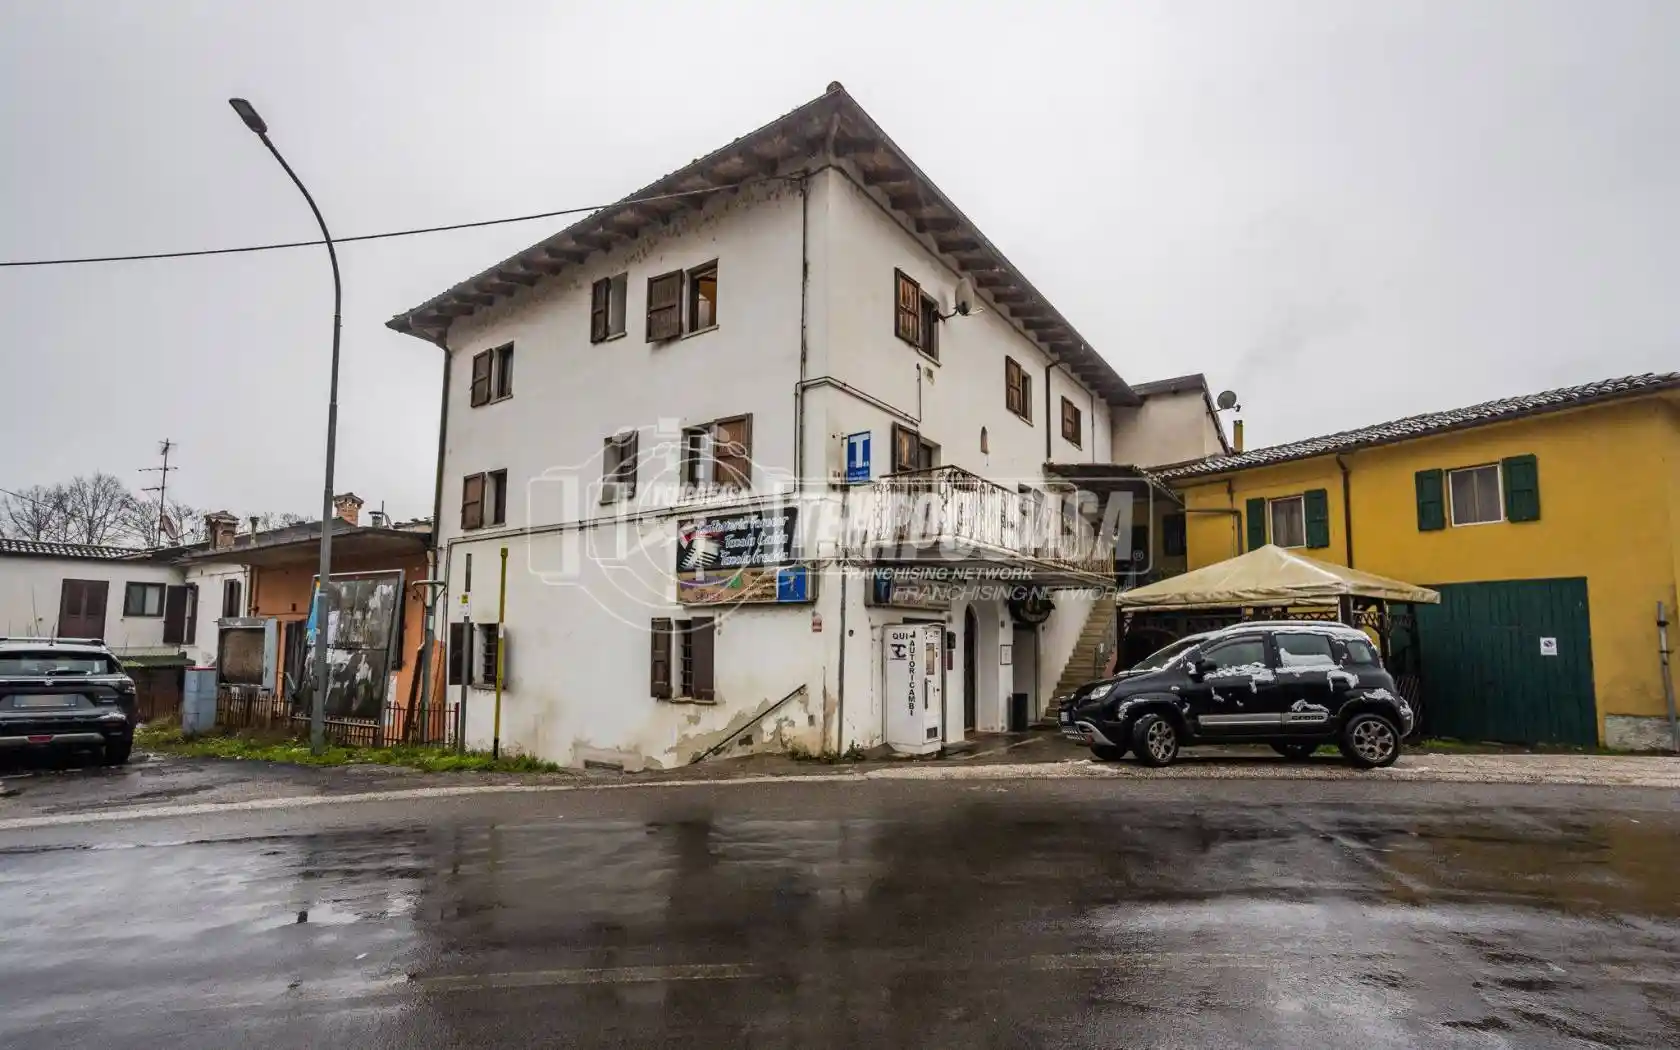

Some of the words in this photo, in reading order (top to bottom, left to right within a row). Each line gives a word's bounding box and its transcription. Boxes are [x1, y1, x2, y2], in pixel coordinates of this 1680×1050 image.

[849, 432, 871, 468] T
[892, 632, 909, 640] QUI
[908, 639, 916, 717] AUTORICAMBI
